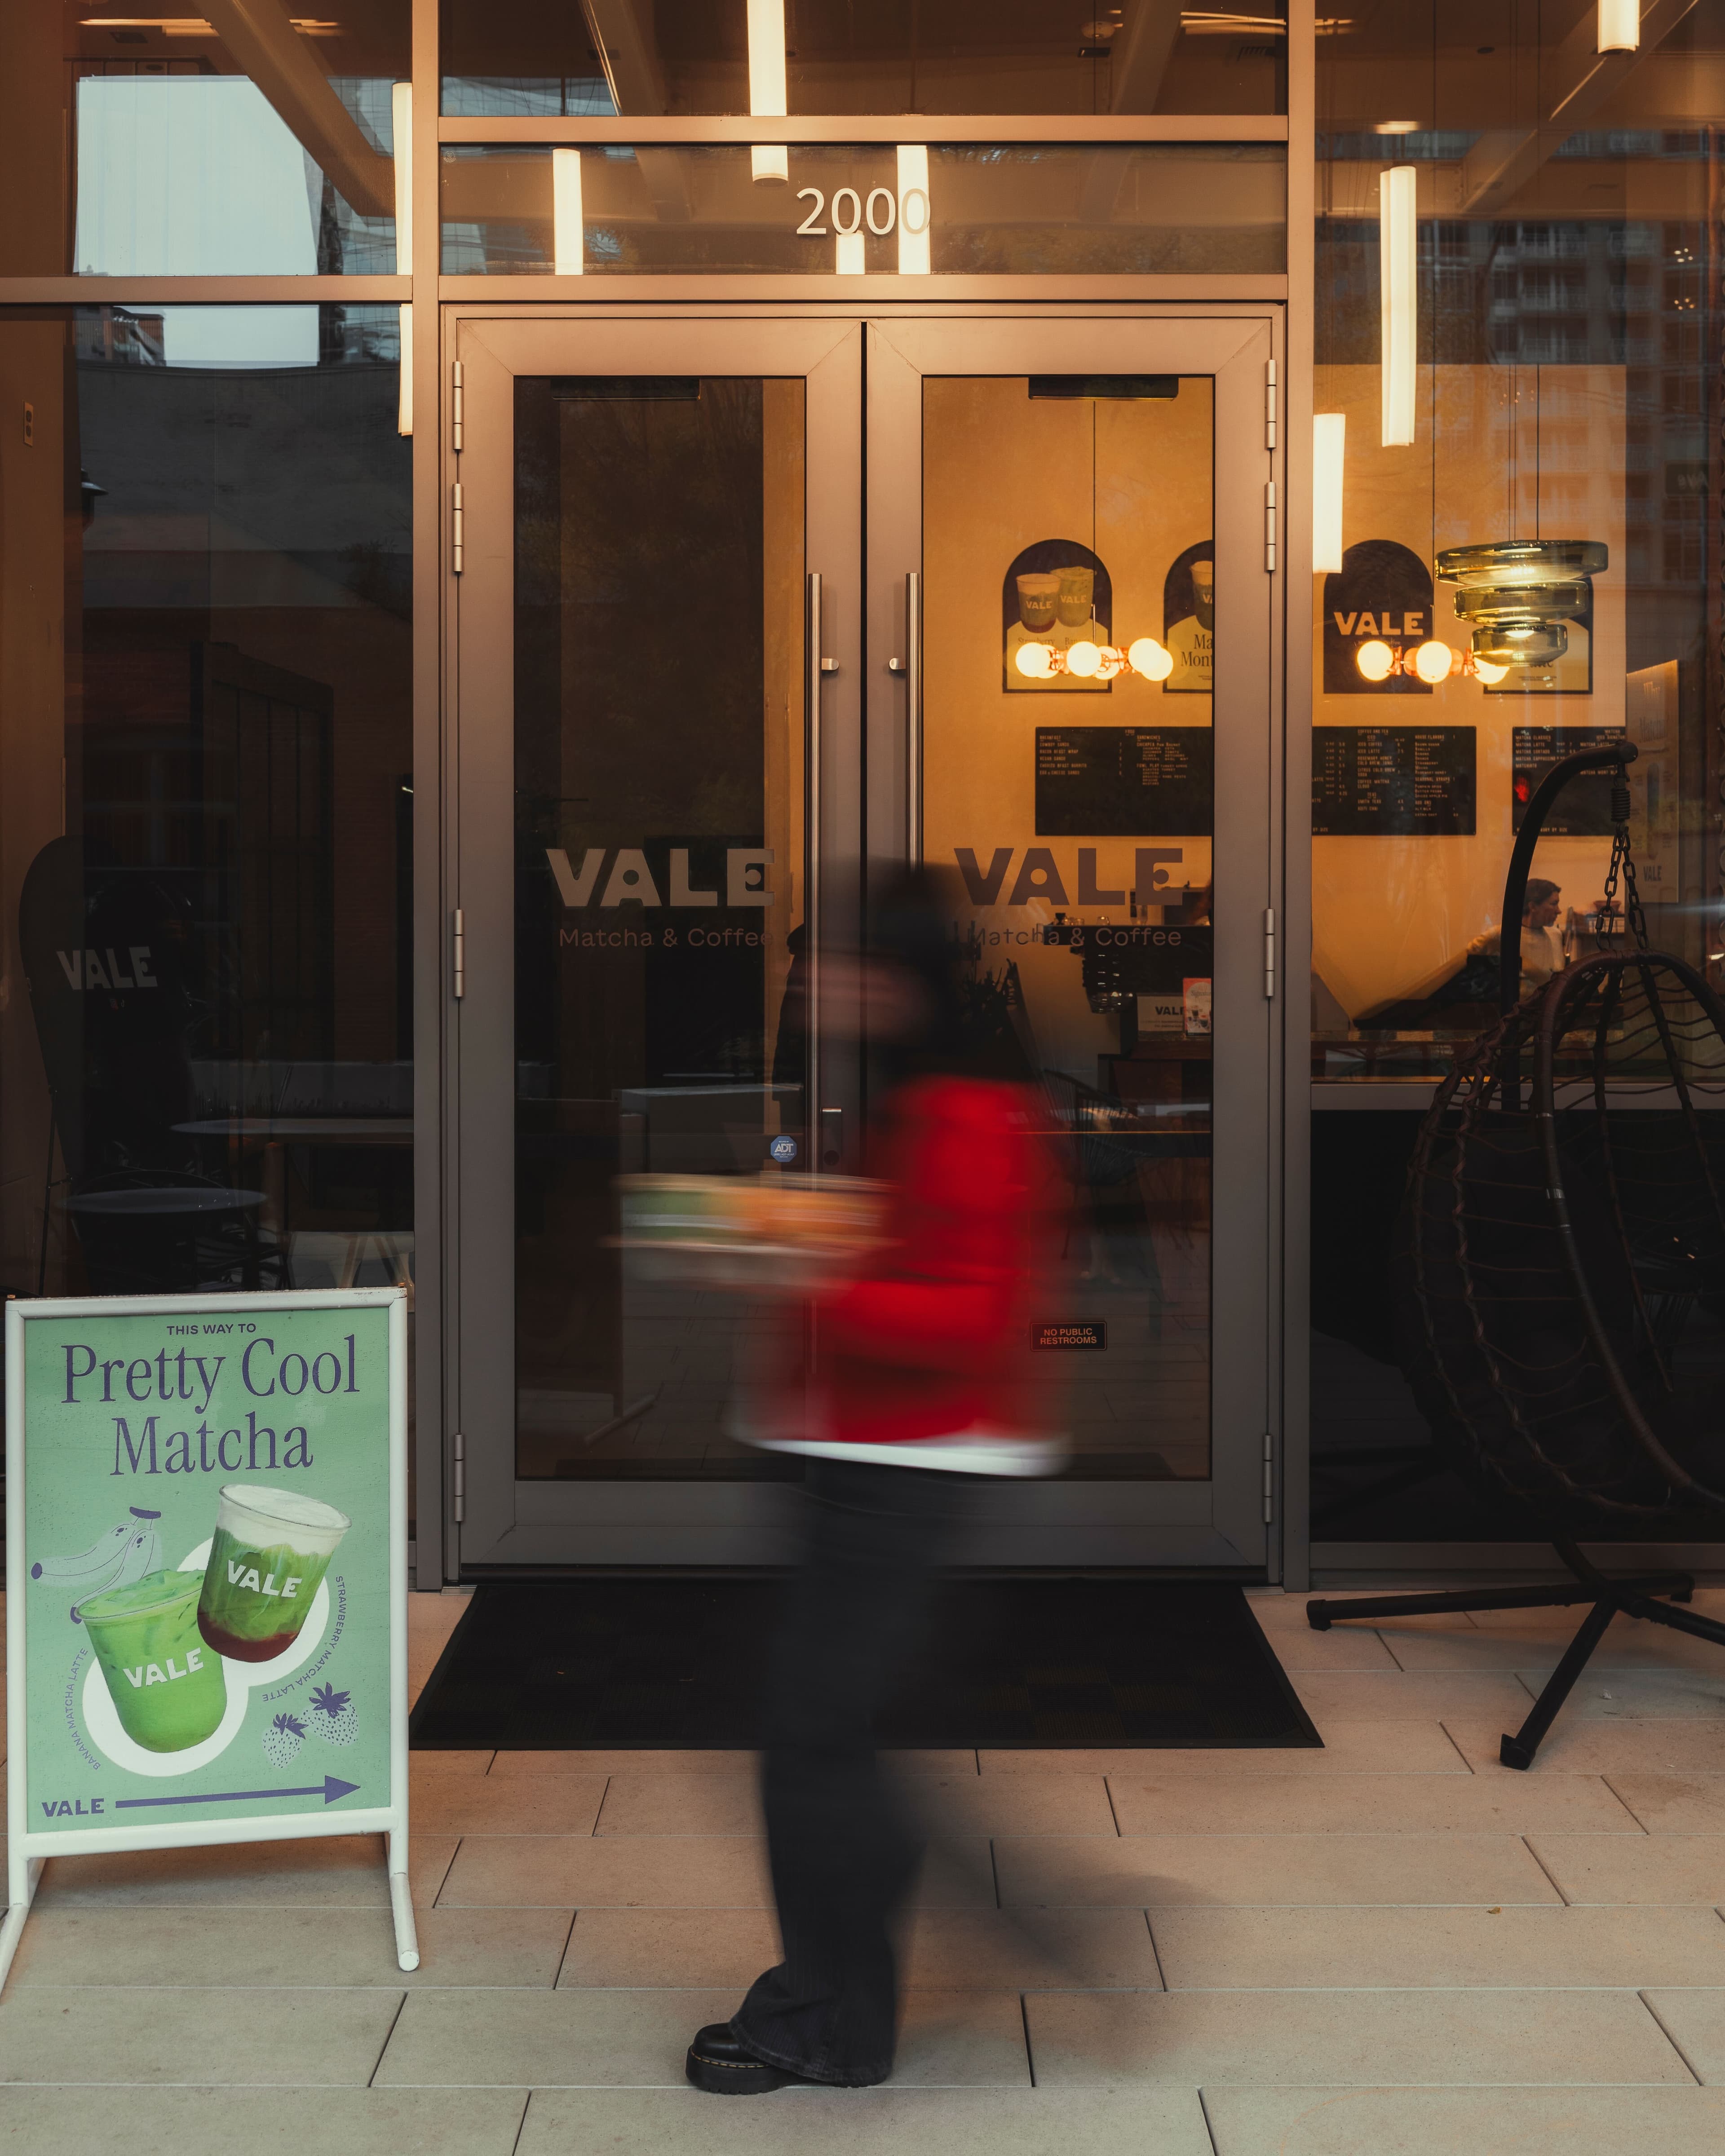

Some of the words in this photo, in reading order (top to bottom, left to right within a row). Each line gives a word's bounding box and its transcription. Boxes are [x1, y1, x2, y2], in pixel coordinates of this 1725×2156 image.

[796, 188, 930, 234] 2000
[1026, 601, 1052, 610] VALE
[1060, 595, 1087, 603] VALE
[1333, 612, 1424, 635] VALE
[545, 848, 774, 906] VALE
[954, 848, 1183, 906] VALE
[559, 928, 654, 946] Matcha
[663, 928, 678, 947] &
[688, 928, 773, 946] Coffee
[967, 927, 1059, 946] Matcha
[1070, 927, 1085, 946] &
[1096, 927, 1181, 946] Coffee
[56, 946, 158, 990] VALE
[774, 1143, 794, 1153] ADT
[167, 1325, 198, 1335] THIS
[203, 1324, 234, 1334] WAY
[238, 1323, 257, 1333] TO
[1040, 1336, 1097, 1344] RESTROOMS
[61, 1345, 226, 1414] Pretty
[242, 1334, 360, 1396] Cool
[110, 1411, 313, 1476] Matcha
[228, 1560, 302, 1598] VALE
[329, 1576, 346, 1649] STRAWBERRY
[68, 1648, 88, 1680] LATTE
[123, 1648, 204, 1688] VALE
[295, 1650, 332, 1686] MATCHA
[65, 1683, 76, 1729] MATCHA
[263, 1683, 295, 1701] LATTE
[72, 1731, 101, 1770] BANANA
[42, 1798, 104, 1817] VALE
